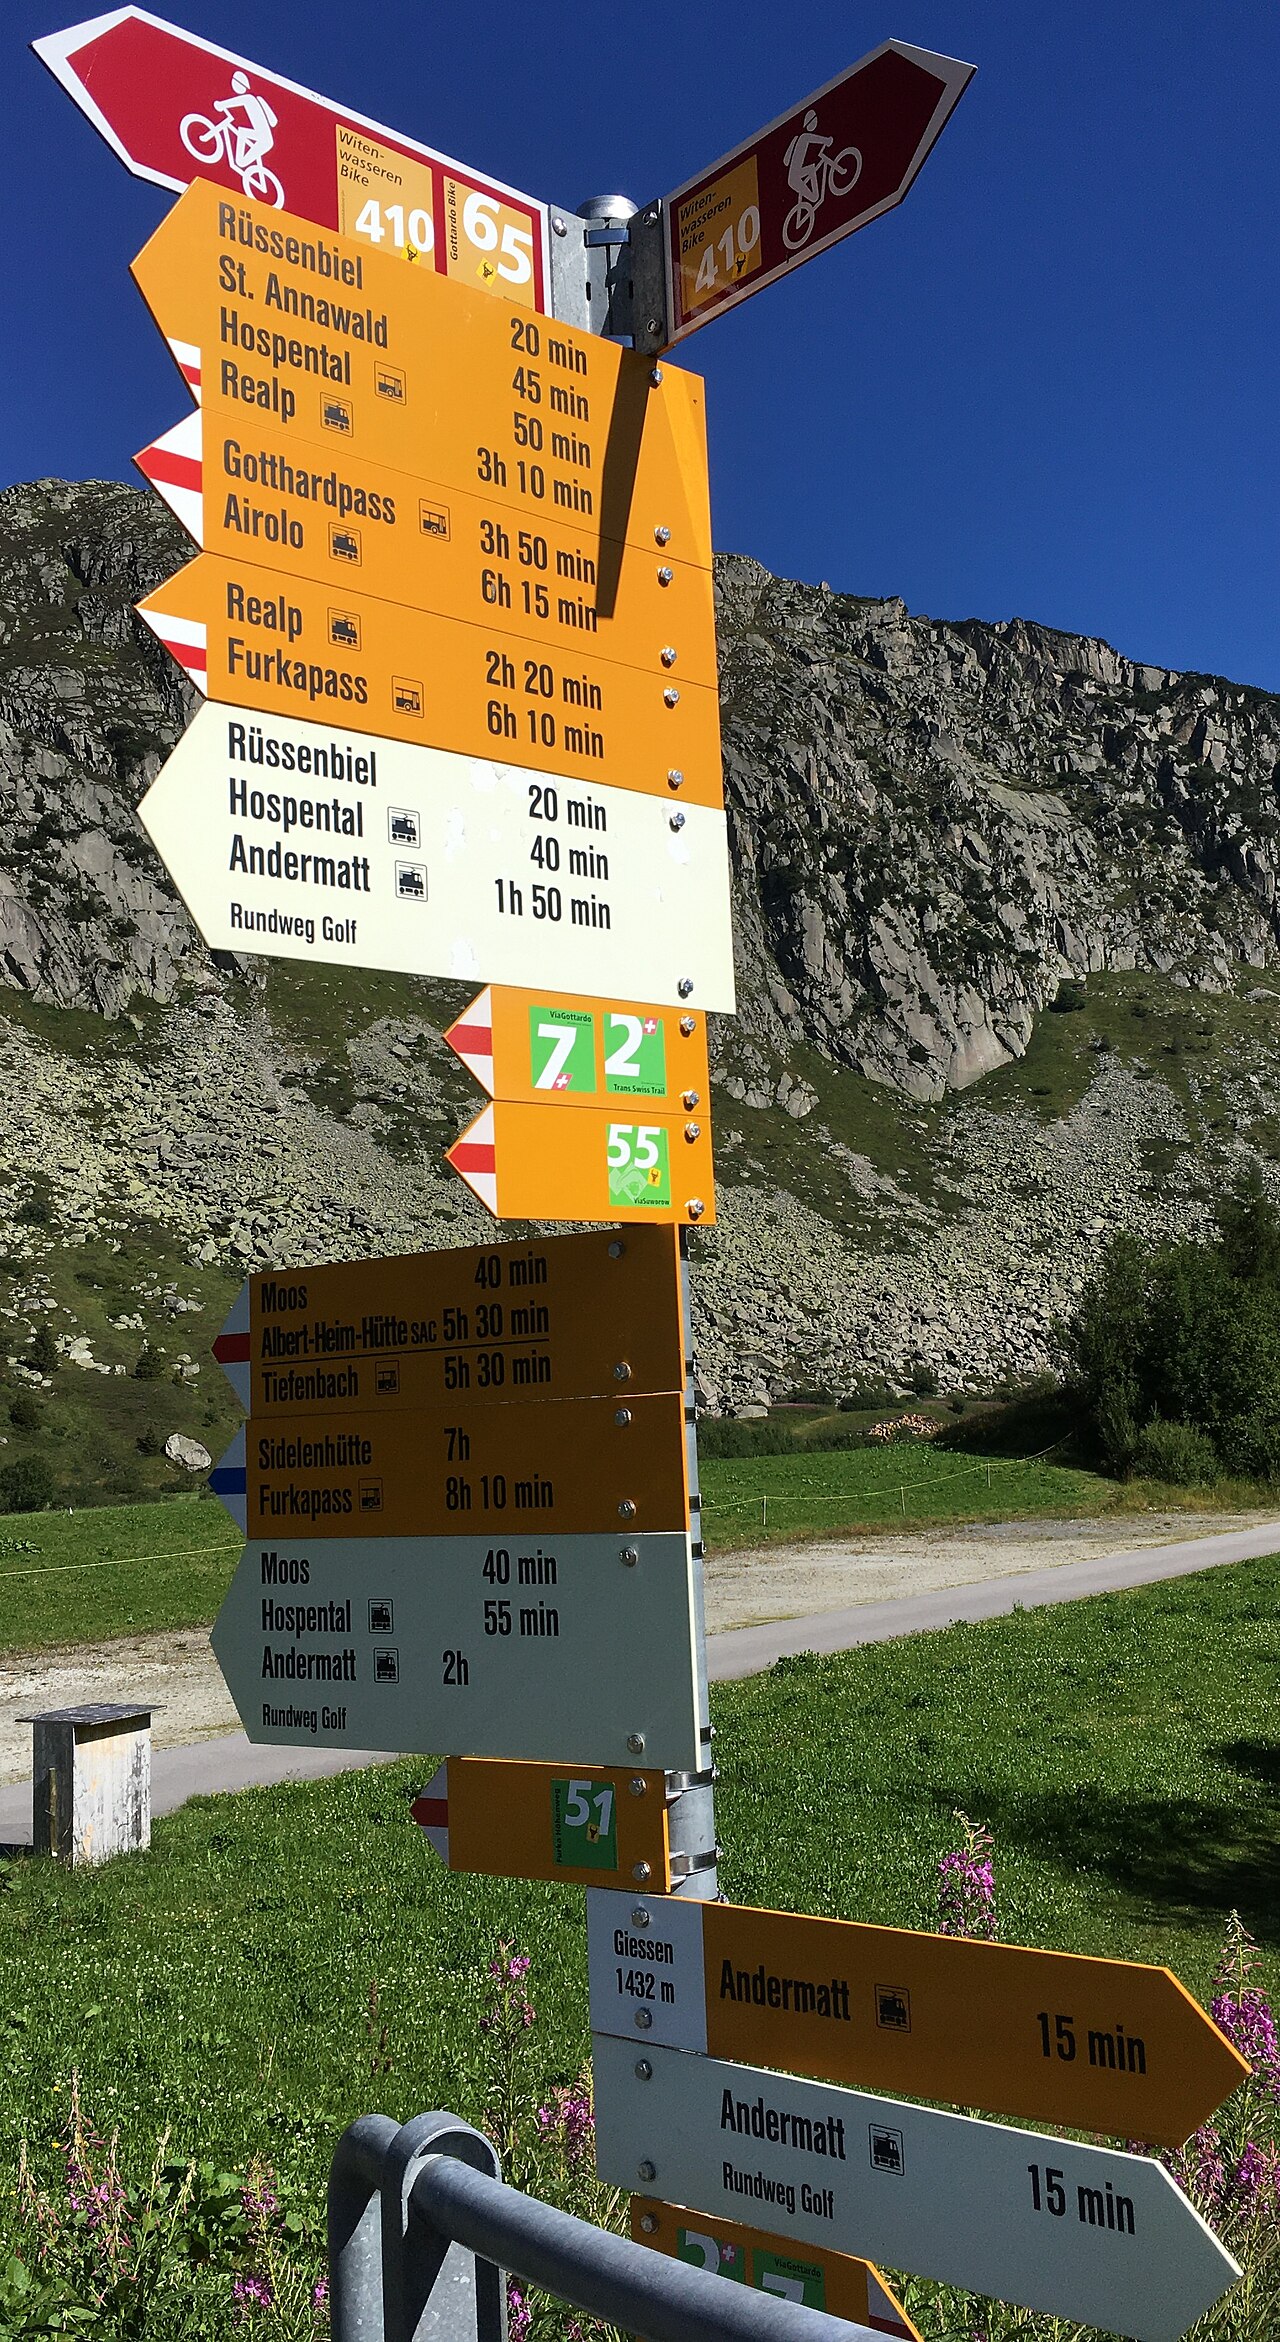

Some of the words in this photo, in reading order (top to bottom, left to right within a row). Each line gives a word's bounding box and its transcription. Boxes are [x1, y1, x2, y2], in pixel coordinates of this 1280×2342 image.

[339, 130, 384, 158] Witen-
[339, 149, 402, 185] wasseren
[340, 164, 369, 187] Bike
[448, 182, 456, 206] Bike
[355, 200, 434, 252] 410
[448, 207, 458, 260] Gottardo
[681, 193, 716, 221] Witen-
[681, 196, 731, 237] wasseren
[463, 192, 533, 284] 65
[682, 231, 705, 254] Bike
[695, 205, 760, 293] 410
[218, 201, 363, 289] Rüssenbiel
[510, 317, 540, 358] 20
[549, 339, 588, 376] min
[218, 257, 254, 300] St.
[265, 272, 388, 349] Annawald
[512, 366, 541, 405] 45
[550, 386, 589, 423] min
[221, 306, 351, 386] Hospental
[514, 413, 542, 451] 50
[552, 432, 591, 469] min
[221, 359, 296, 424] Realp
[477, 447, 506, 487] 3h
[517, 460, 545, 498] 10
[554, 478, 593, 516] min
[223, 439, 395, 525] Gotthardpass
[480, 519, 509, 560] 3h
[518, 530, 548, 570] 50
[556, 549, 595, 585] min
[223, 493, 303, 549] Airolo
[481, 569, 511, 609] 6h
[522, 580, 549, 619] 15
[558, 597, 597, 633] min
[226, 582, 303, 643] Realp
[486, 651, 515, 690] 2h
[524, 660, 554, 699] 20
[562, 675, 602, 711] min
[227, 638, 368, 705] Furkapass
[487, 700, 517, 739] 6h
[528, 710, 555, 748] 10
[564, 723, 604, 759] min
[228, 721, 377, 787] Rüssenbiel
[528, 785, 558, 821] 20
[567, 796, 607, 832] min
[229, 779, 364, 838] Hospental
[530, 835, 560, 870] 40
[569, 845, 609, 881] min
[229, 834, 370, 893] Andermatt
[495, 879, 523, 918] 1h
[531, 886, 563, 923] 50
[571, 894, 611, 930] min
[230, 903, 315, 944] Rundweg
[322, 915, 357, 944] Golf
[549, 1011, 592, 1023] ViaGottardo
[535, 1023, 577, 1089] 7
[605, 1013, 643, 1076] 2
[614, 1084, 631, 1093] Trans
[632, 1085, 650, 1094] Swiss
[651, 1087, 665, 1095] Trail
[607, 1124, 660, 1169] 55
[261, 1282, 307, 1313] Moos
[474, 1255, 500, 1290] 40
[509, 1251, 548, 1287] min
[261, 1314, 408, 1358] Albert-Heim-Hütte
[411, 1321, 437, 1345] SAC
[443, 1307, 469, 1340] 5h
[476, 1303, 503, 1337] 30
[511, 1300, 550, 1334] min
[262, 1365, 359, 1402] Tiefenbach
[444, 1356, 470, 1389] 5h
[477, 1353, 504, 1386] 30
[512, 1349, 551, 1384] min
[259, 1435, 372, 1470] Sidelenhütte
[444, 1427, 470, 1461] 7h
[259, 1484, 352, 1521] Furkapass
[446, 1477, 471, 1511] 8h
[481, 1475, 506, 1510] 10
[515, 1473, 554, 1509] min
[261, 1552, 310, 1585] Moos
[482, 1549, 510, 1585] 40
[518, 1549, 557, 1585] min
[261, 1599, 351, 1639] Hospental
[483, 1600, 512, 1636] 55
[520, 1600, 559, 1636] min
[261, 1646, 356, 1681] Andermatt
[442, 1650, 469, 1686] 2h
[262, 1703, 317, 1733] Rundweg
[322, 1704, 347, 1731] Golf
[565, 1780, 613, 1836] 51
[614, 1929, 674, 1965] Giessen
[616, 1967, 656, 2001] 1432
[661, 1980, 675, 2004] m
[720, 1959, 850, 2021] Andermatt
[1037, 2011, 1075, 2062] 15
[1088, 2025, 1147, 2074] min
[721, 2089, 846, 2162] Andermatt
[1027, 2163, 1066, 2218] 15
[1077, 2178, 1135, 2236] min
[722, 2161, 795, 2216] Rundweg
[800, 2182, 834, 2220] Golf
[774, 2258, 822, 2278] ViaGottardo
